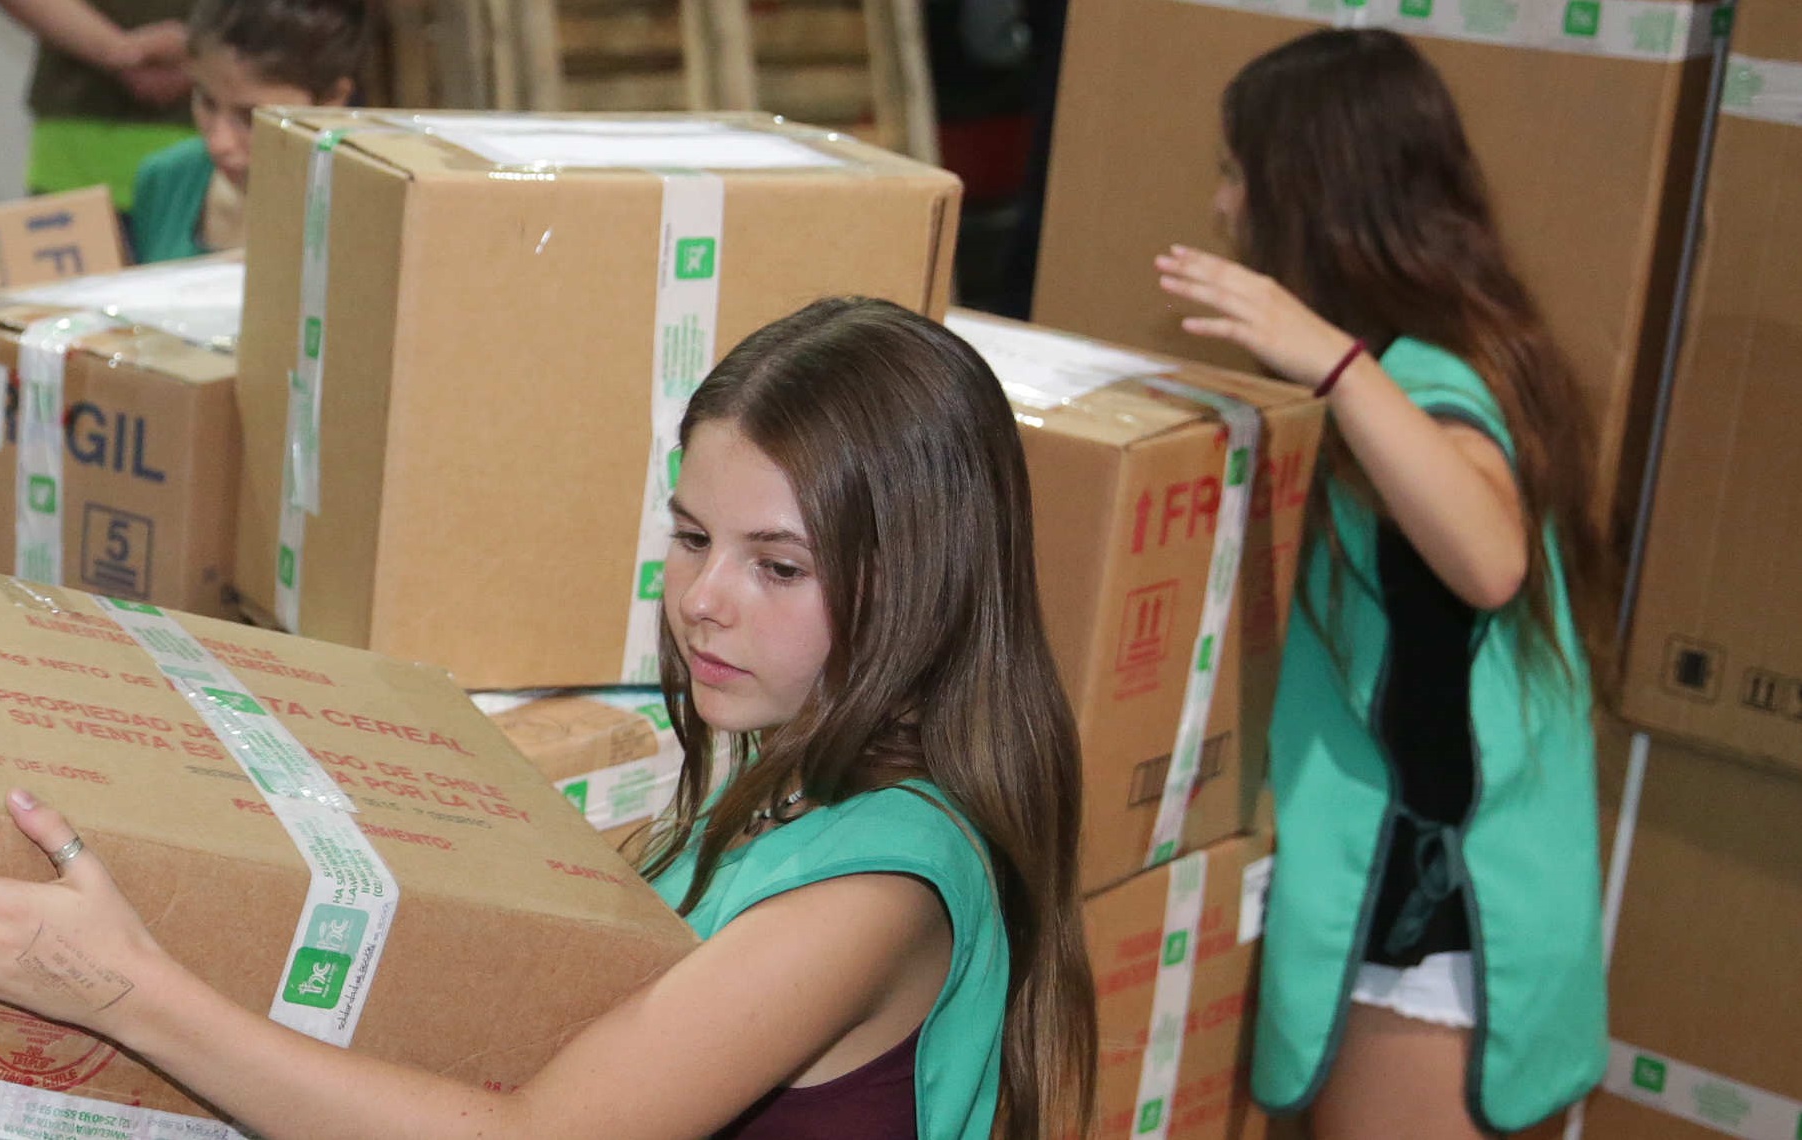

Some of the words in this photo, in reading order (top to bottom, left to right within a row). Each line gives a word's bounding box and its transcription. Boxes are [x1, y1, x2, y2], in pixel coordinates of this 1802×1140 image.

[65, 400, 166, 484] GIL
[107, 519, 131, 562] 5
[37, 657, 111, 678] NETO
[119, 672, 158, 688] DE
[320, 709, 476, 757] CEREAL
[8, 709, 55, 729] SU
[62, 719, 175, 751] VENTA
[180, 741, 225, 760] ES
[361, 776, 428, 802] POR
[431, 790, 472, 809] LA
[477, 803, 531, 823] LEY
[376, 761, 420, 782] DE
[425, 772, 511, 802] CHILE
[41, 1069, 79, 1089] CHILE
